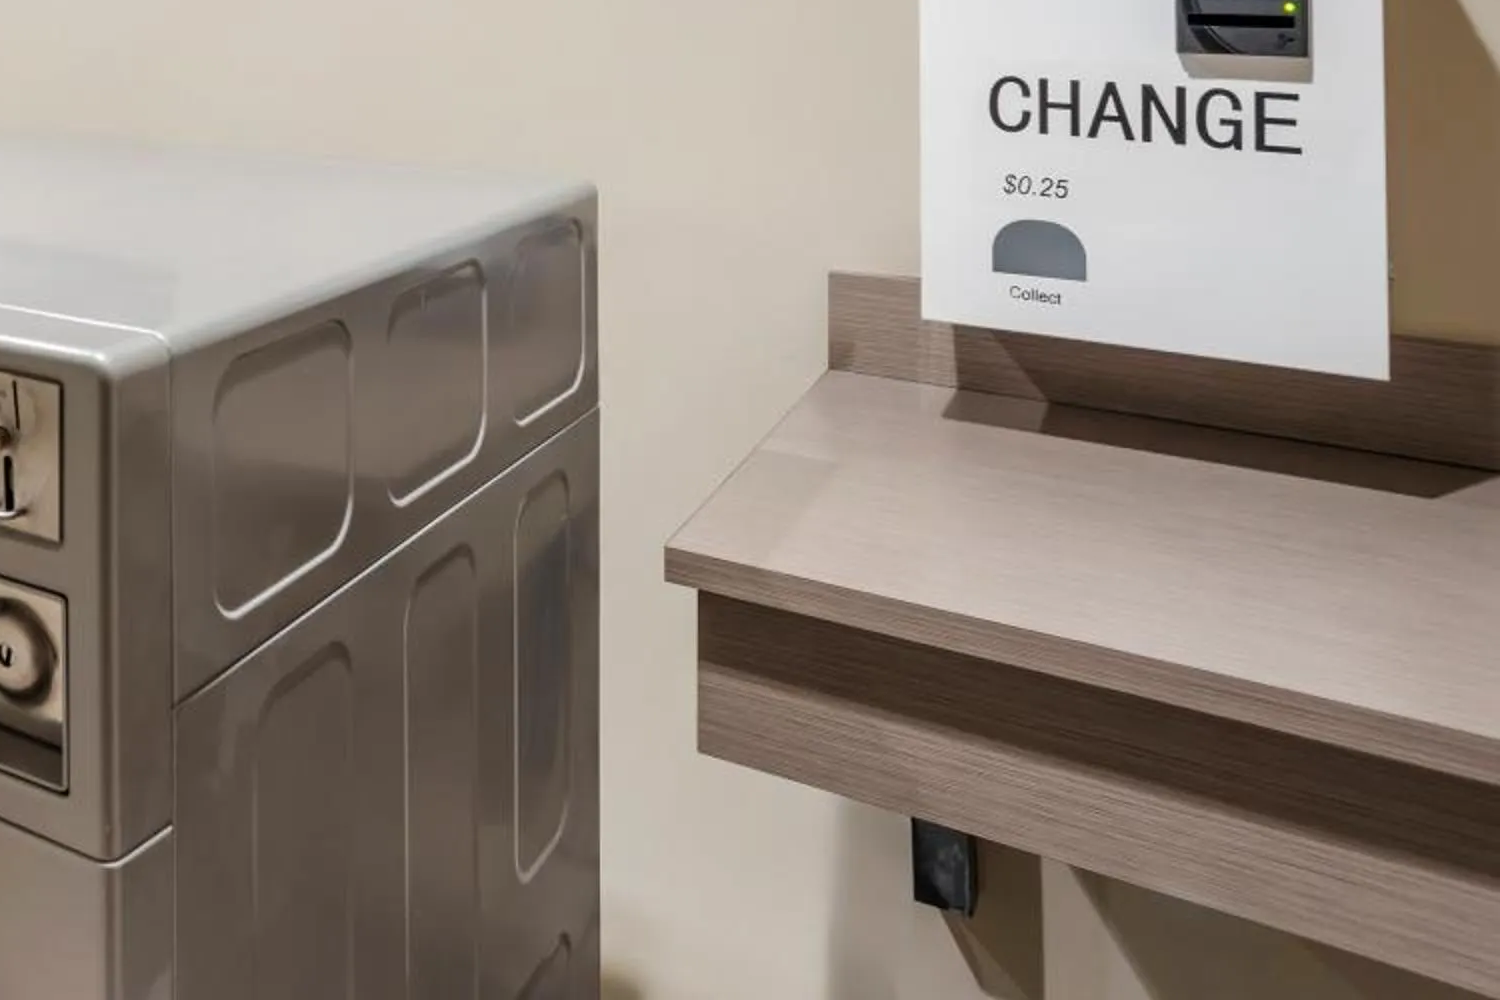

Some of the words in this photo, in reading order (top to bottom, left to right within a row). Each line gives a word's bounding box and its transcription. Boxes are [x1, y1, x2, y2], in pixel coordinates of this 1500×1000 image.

[989, 75, 1303, 155] CHANGE
[1003, 174, 1069, 199] $0.25
[1009, 284, 1062, 306] Collect
